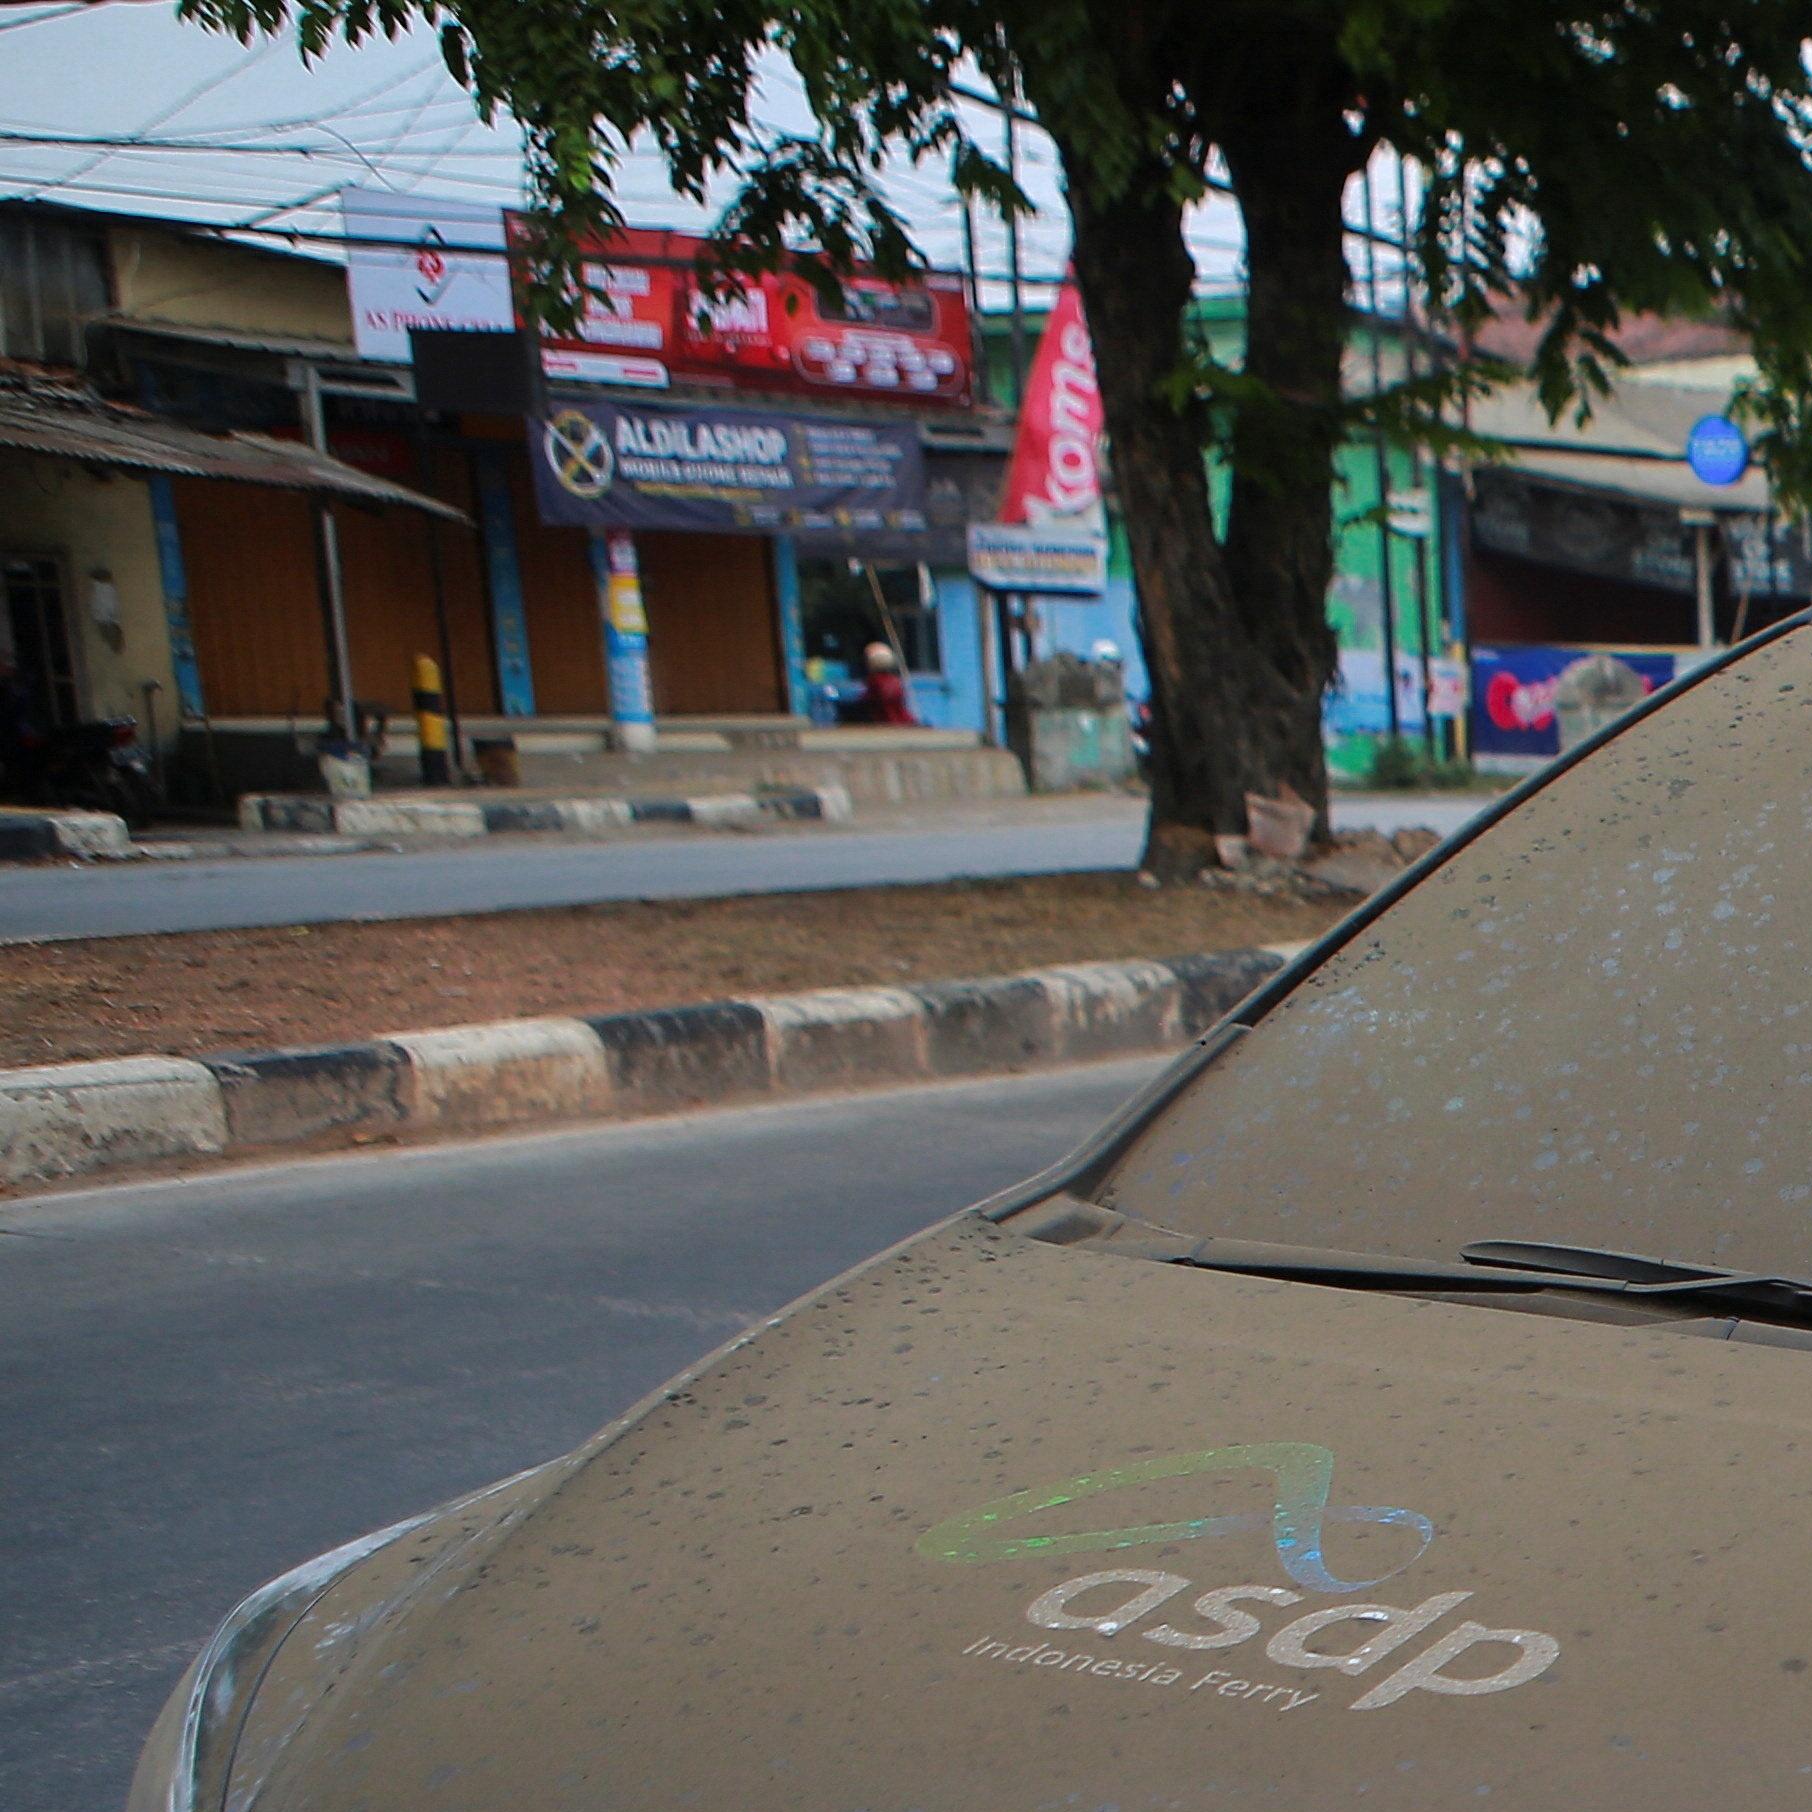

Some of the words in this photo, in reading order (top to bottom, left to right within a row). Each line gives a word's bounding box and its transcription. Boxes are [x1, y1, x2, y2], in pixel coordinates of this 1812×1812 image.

[614, 415, 789, 465] ALDILASHOP
[963, 1634, 1182, 1687] Indonesia
[1190, 1669, 1322, 1713] Ferry
[1026, 1568, 1561, 1710] asdp
